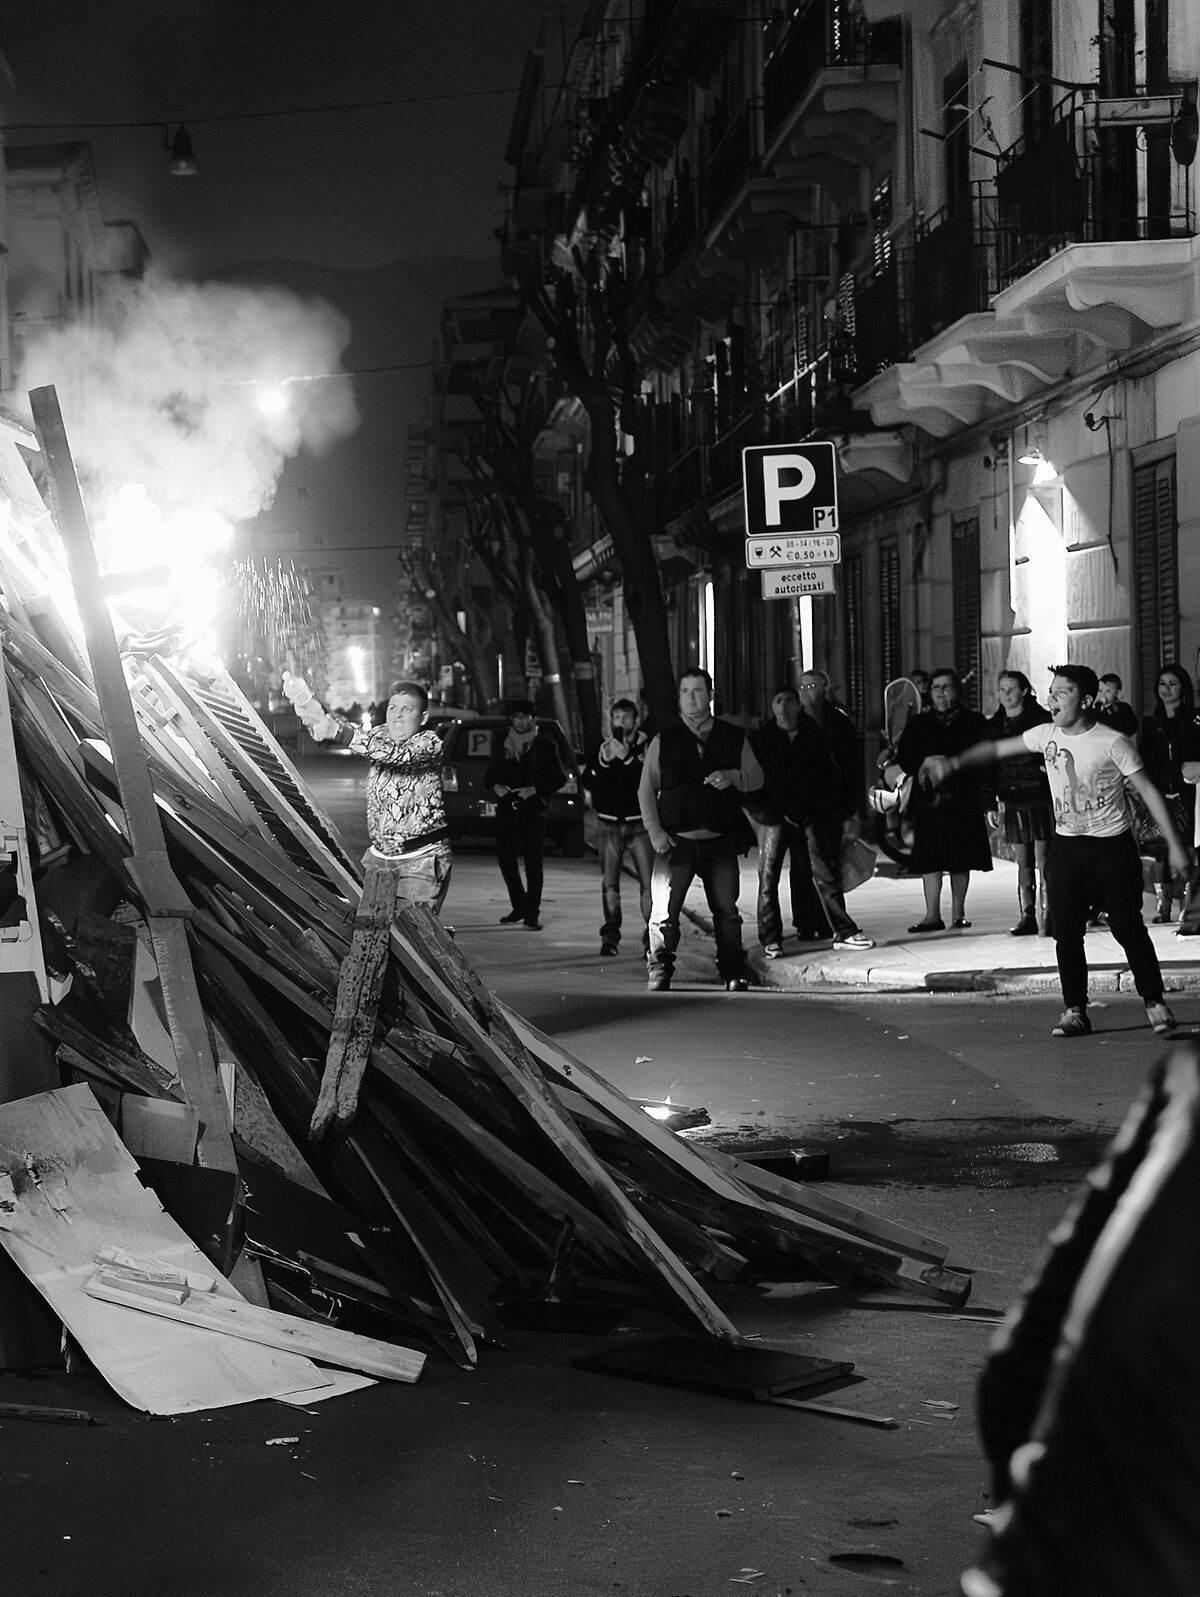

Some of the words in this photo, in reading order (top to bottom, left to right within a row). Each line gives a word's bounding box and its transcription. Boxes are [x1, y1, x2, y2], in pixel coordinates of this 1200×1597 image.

[763, 454, 816, 526] P
[815, 508, 836, 528] P1
[781, 571, 817, 582] eccetto
[774, 581, 824, 594] autorizzati
[472, 734, 487, 753] P
